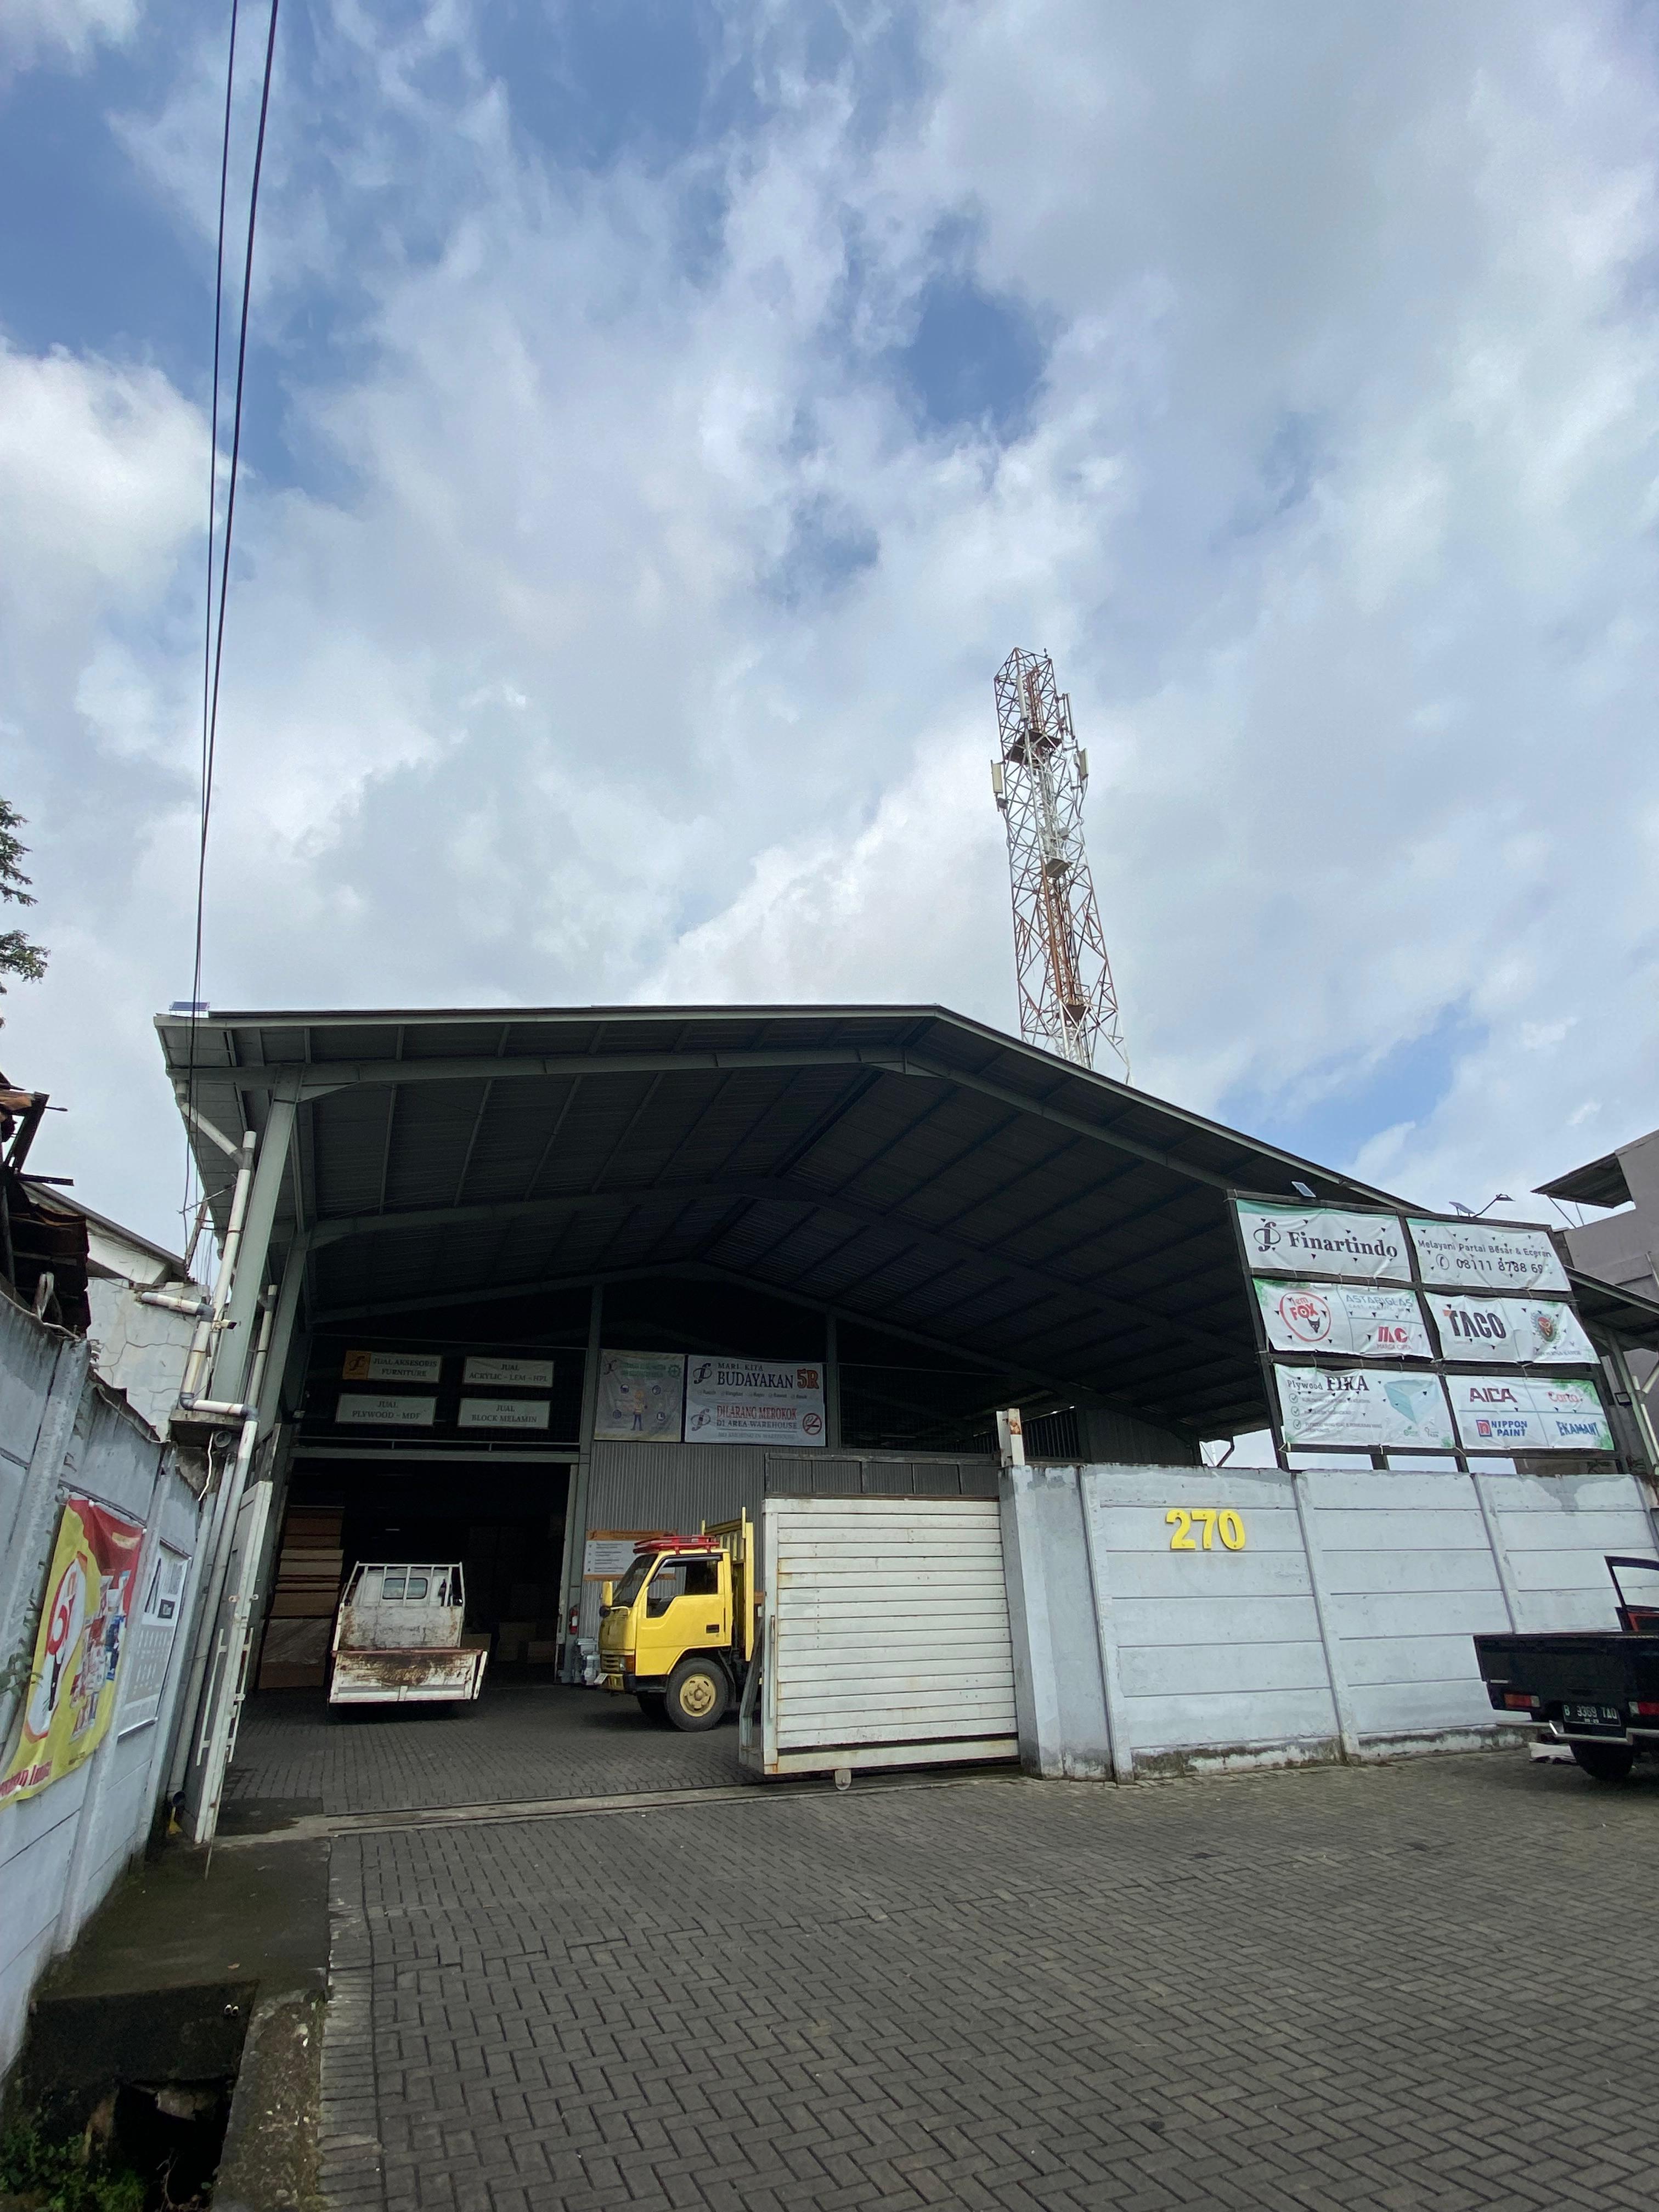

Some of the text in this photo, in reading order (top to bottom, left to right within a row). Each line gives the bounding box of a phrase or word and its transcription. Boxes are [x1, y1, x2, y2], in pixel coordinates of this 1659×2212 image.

[1287, 1231, 1398, 1258] Finartindo
[1418, 1240, 1456, 1251] Melayani
[1458, 1243, 1486, 1252] Partai
[1488, 1245, 1513, 1255] Besar
[1456, 1257, 1492, 1271] 08111
[1498, 1260, 1527, 1273] 8788
[1289, 1302, 1319, 1321] FOX
[1442, 1308, 1506, 1339] TACO
[381, 1369, 427, 1377] FURNITURE
[469, 1372, 503, 1380] ACRYLIC
[717, 1368, 820, 1389] BUDAYAKAN 5R
[1287, 1375, 1370, 1392] Plywood FIKA
[1470, 1388, 1518, 1403] AICA
[352, 1410, 394, 1419] PLYWOOD
[716, 1405, 798, 1421] DILARANG MEROKOK
[750, 1421, 798, 1430] WAREHOUSE
[1491, 1420, 1527, 1429] NIPPON
[1166, 1509, 1246, 1550] 270
[1564, 1705, 1571, 1716] B
